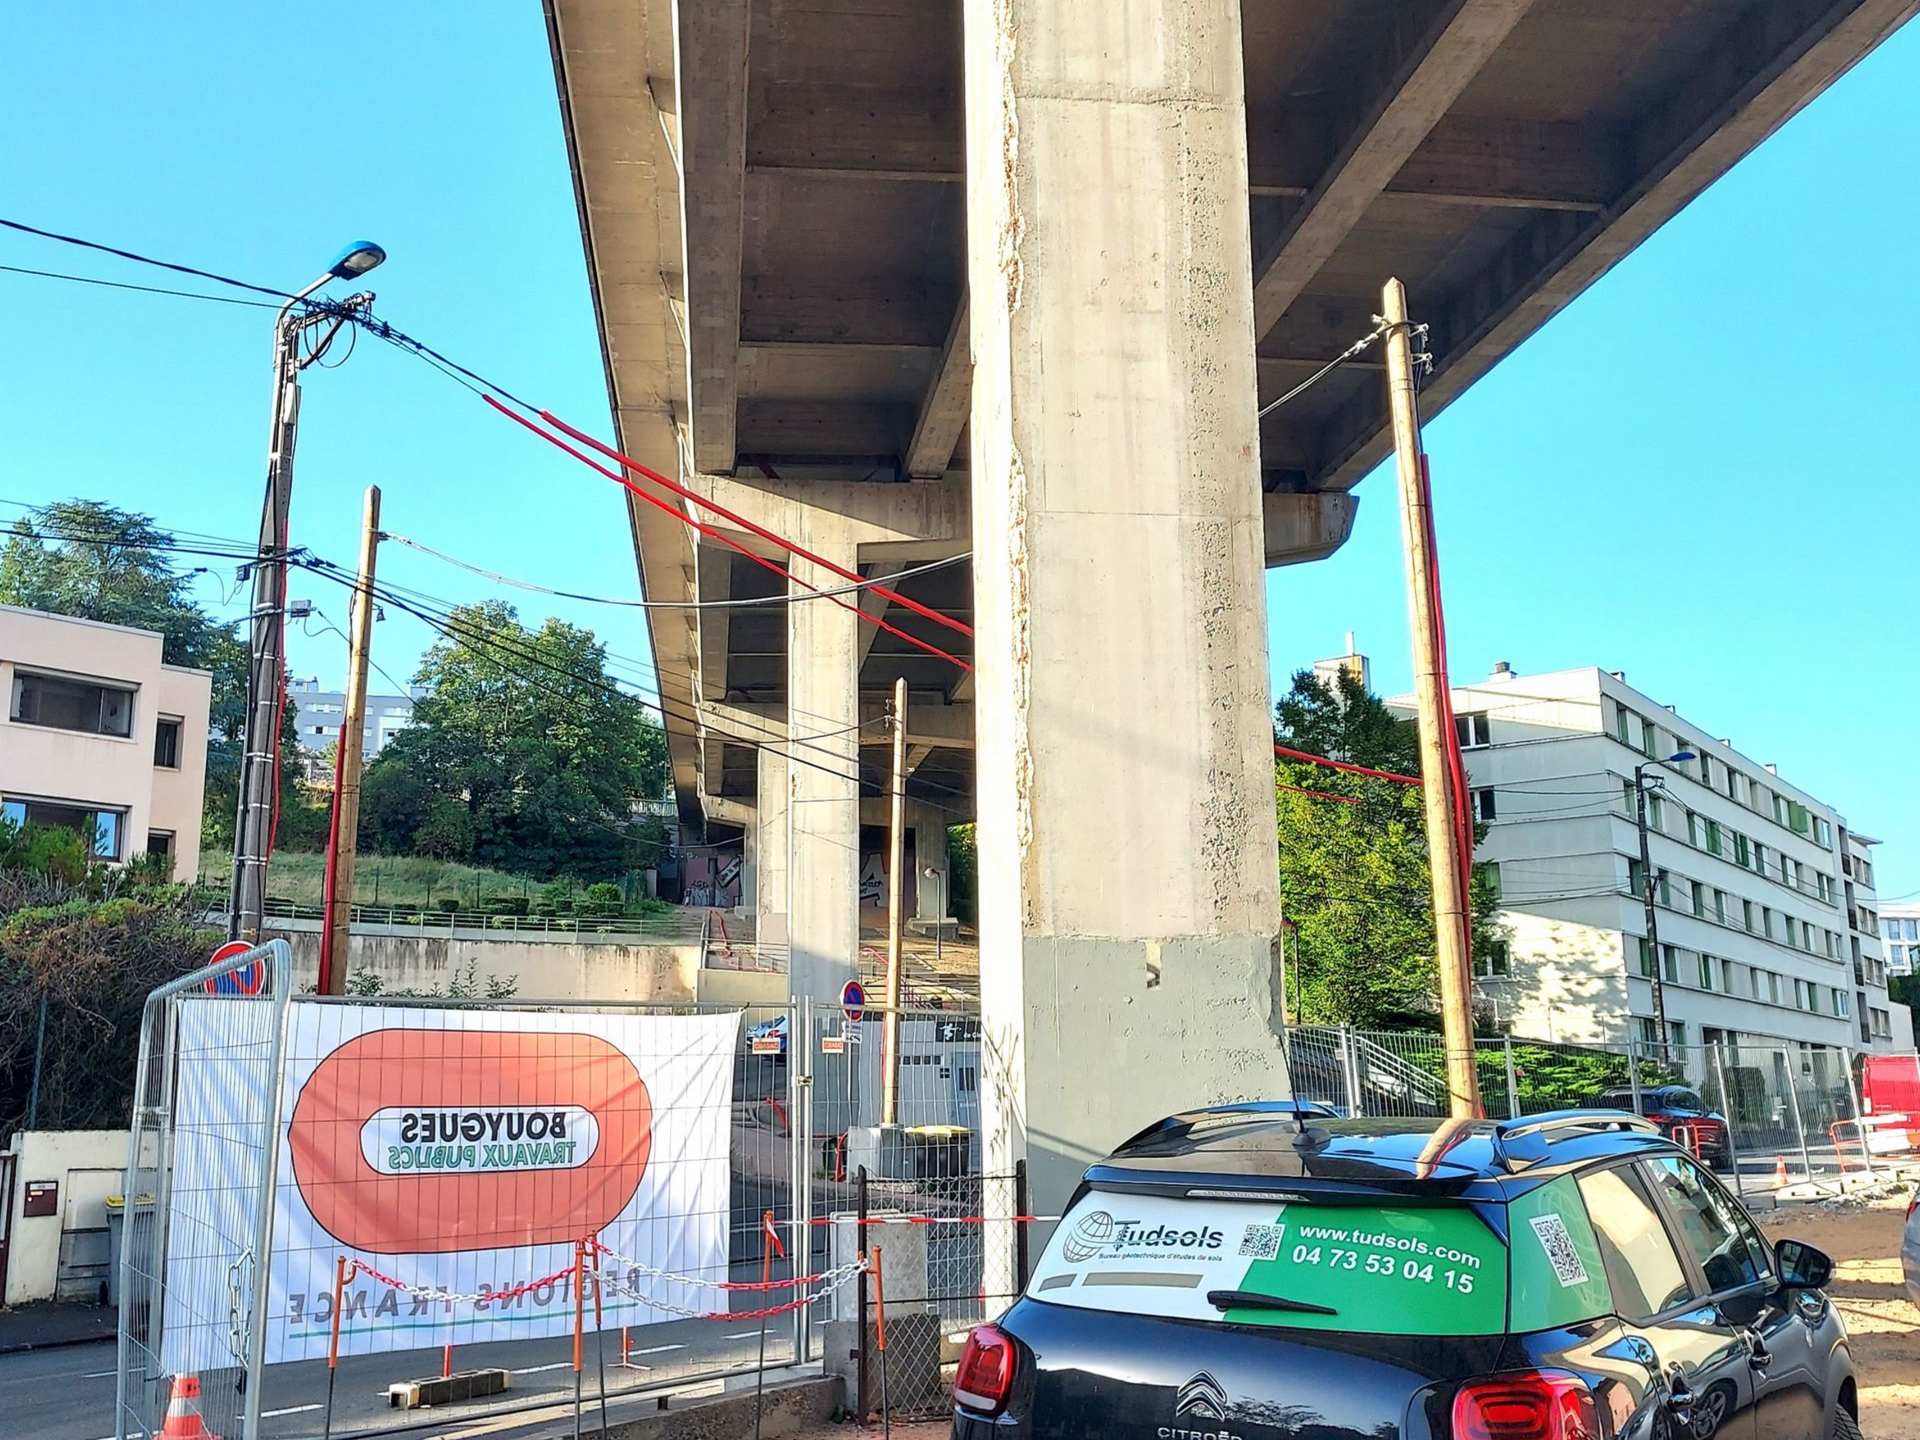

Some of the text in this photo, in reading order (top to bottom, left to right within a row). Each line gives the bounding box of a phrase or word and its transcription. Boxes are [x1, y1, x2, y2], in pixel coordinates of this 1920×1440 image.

[1114, 1220, 1224, 1252] Tudsols
[1299, 1225, 1482, 1269] www.tudsols.com
[1098, 1252, 1121, 1260] Bureau
[1121, 1252, 1166, 1260] géotechnique
[1292, 1244, 1474, 1294] 04 73 53 04 15
